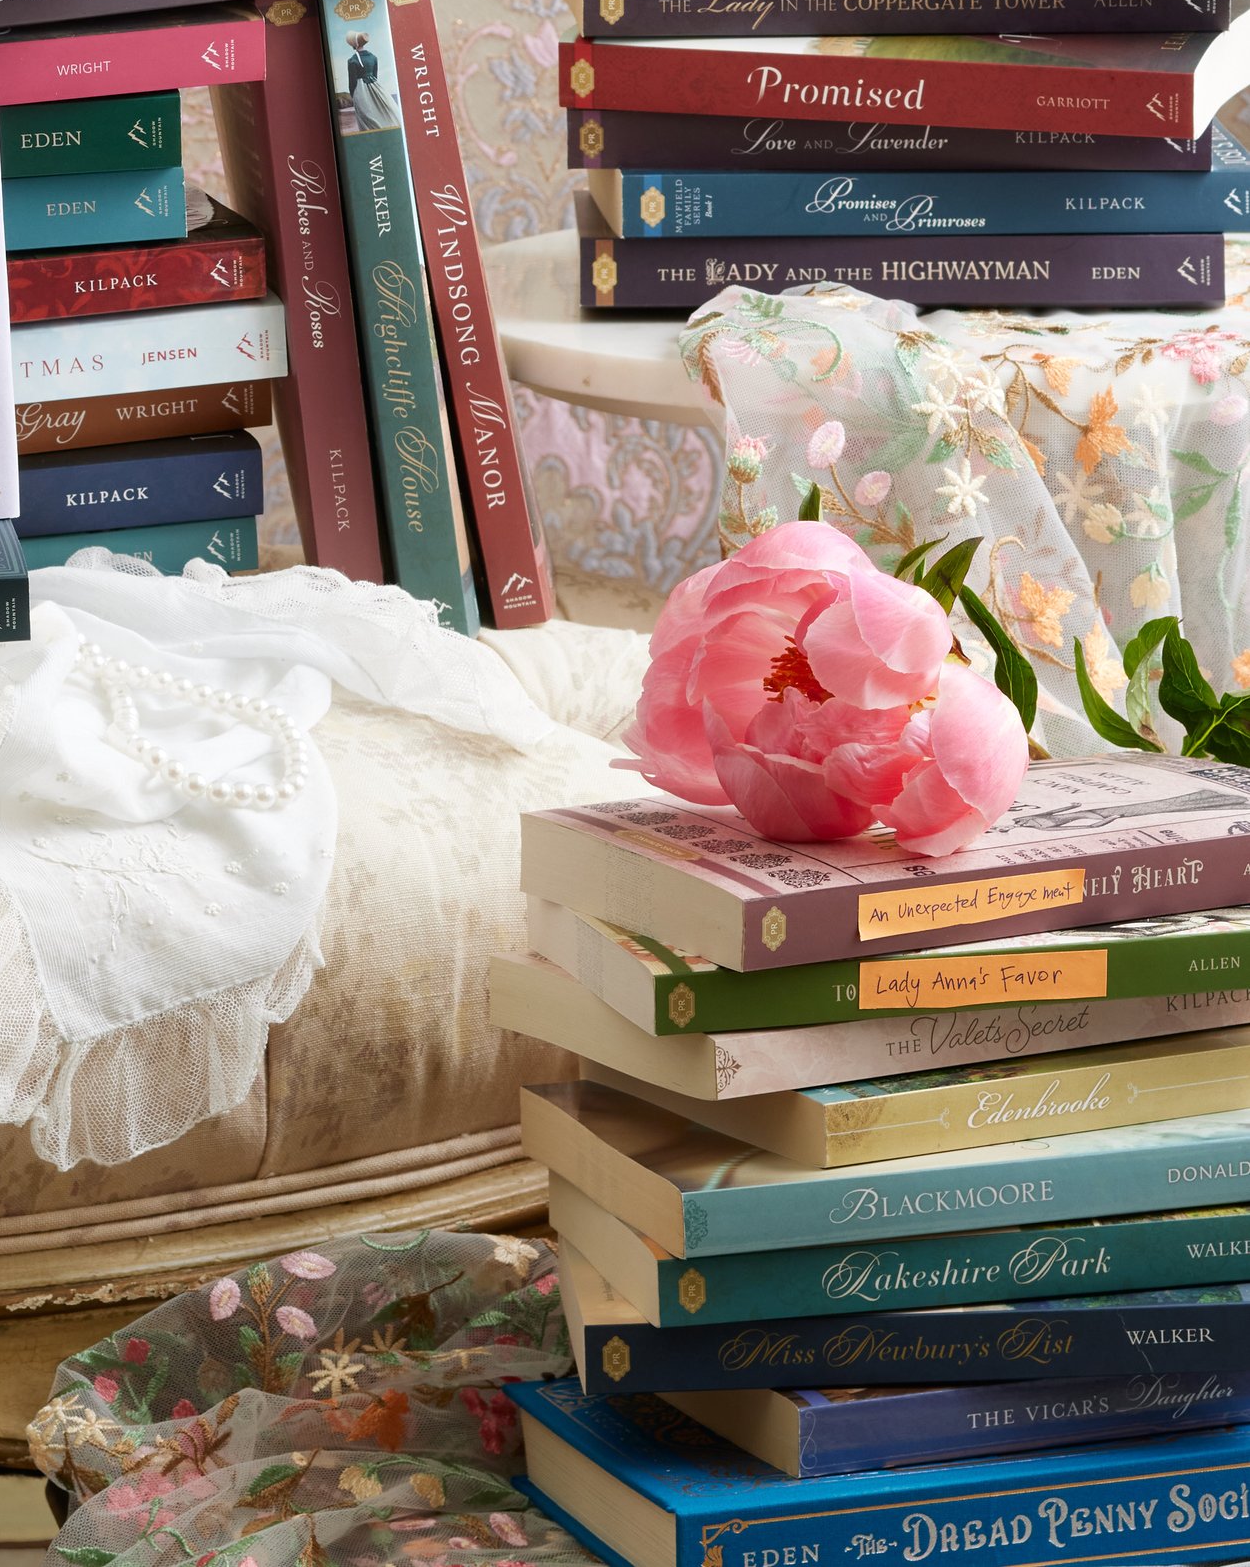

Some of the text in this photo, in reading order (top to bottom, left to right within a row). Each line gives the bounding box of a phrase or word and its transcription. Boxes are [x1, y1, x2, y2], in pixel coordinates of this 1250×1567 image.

[57, 61, 111, 76] WRIGHT
[411, 43, 439, 137] WRIGHT
[747, 66, 924, 109] Promised
[1037, 96, 1110, 109] GARRIOTT
[21, 131, 81, 148] EDEN
[47, 201, 95, 216] EDEN
[369, 154, 391, 237] WALKER
[805, 177, 898, 214] Promises
[1066, 198, 1145, 209] KILPACK
[886, 195, 985, 231] Primroses
[288, 155, 339, 348] Rakes Roses
[75, 274, 157, 293] KILPACK
[658, 269, 695, 281] THE
[786, 268, 826, 280] AND
[835, 268, 872, 280] THE
[882, 261, 1049, 280] HIGHWAYMAN
[1093, 268, 1139, 279] EDEN
[142, 348, 196, 365] JENSEN
[373, 261, 439, 532] Highcliffe House
[116, 400, 197, 420] WRIGHT
[66, 487, 148, 506] KILPACK
[330, 450, 350, 532] KILPACK
[869, 889, 978, 922] An Unexpected
[1189, 957, 1240, 971] ALLEN
[877, 971, 920, 1008] Lady
[1001, 966, 1062, 992] Favor
[968, 1074, 1110, 1128] Edenbrooke
[822, 1237, 1110, 1301] Lakeshire Park
[718, 1319, 1072, 1370] Miss Newbury's List
[1126, 1328, 1214, 1344] WALKER
